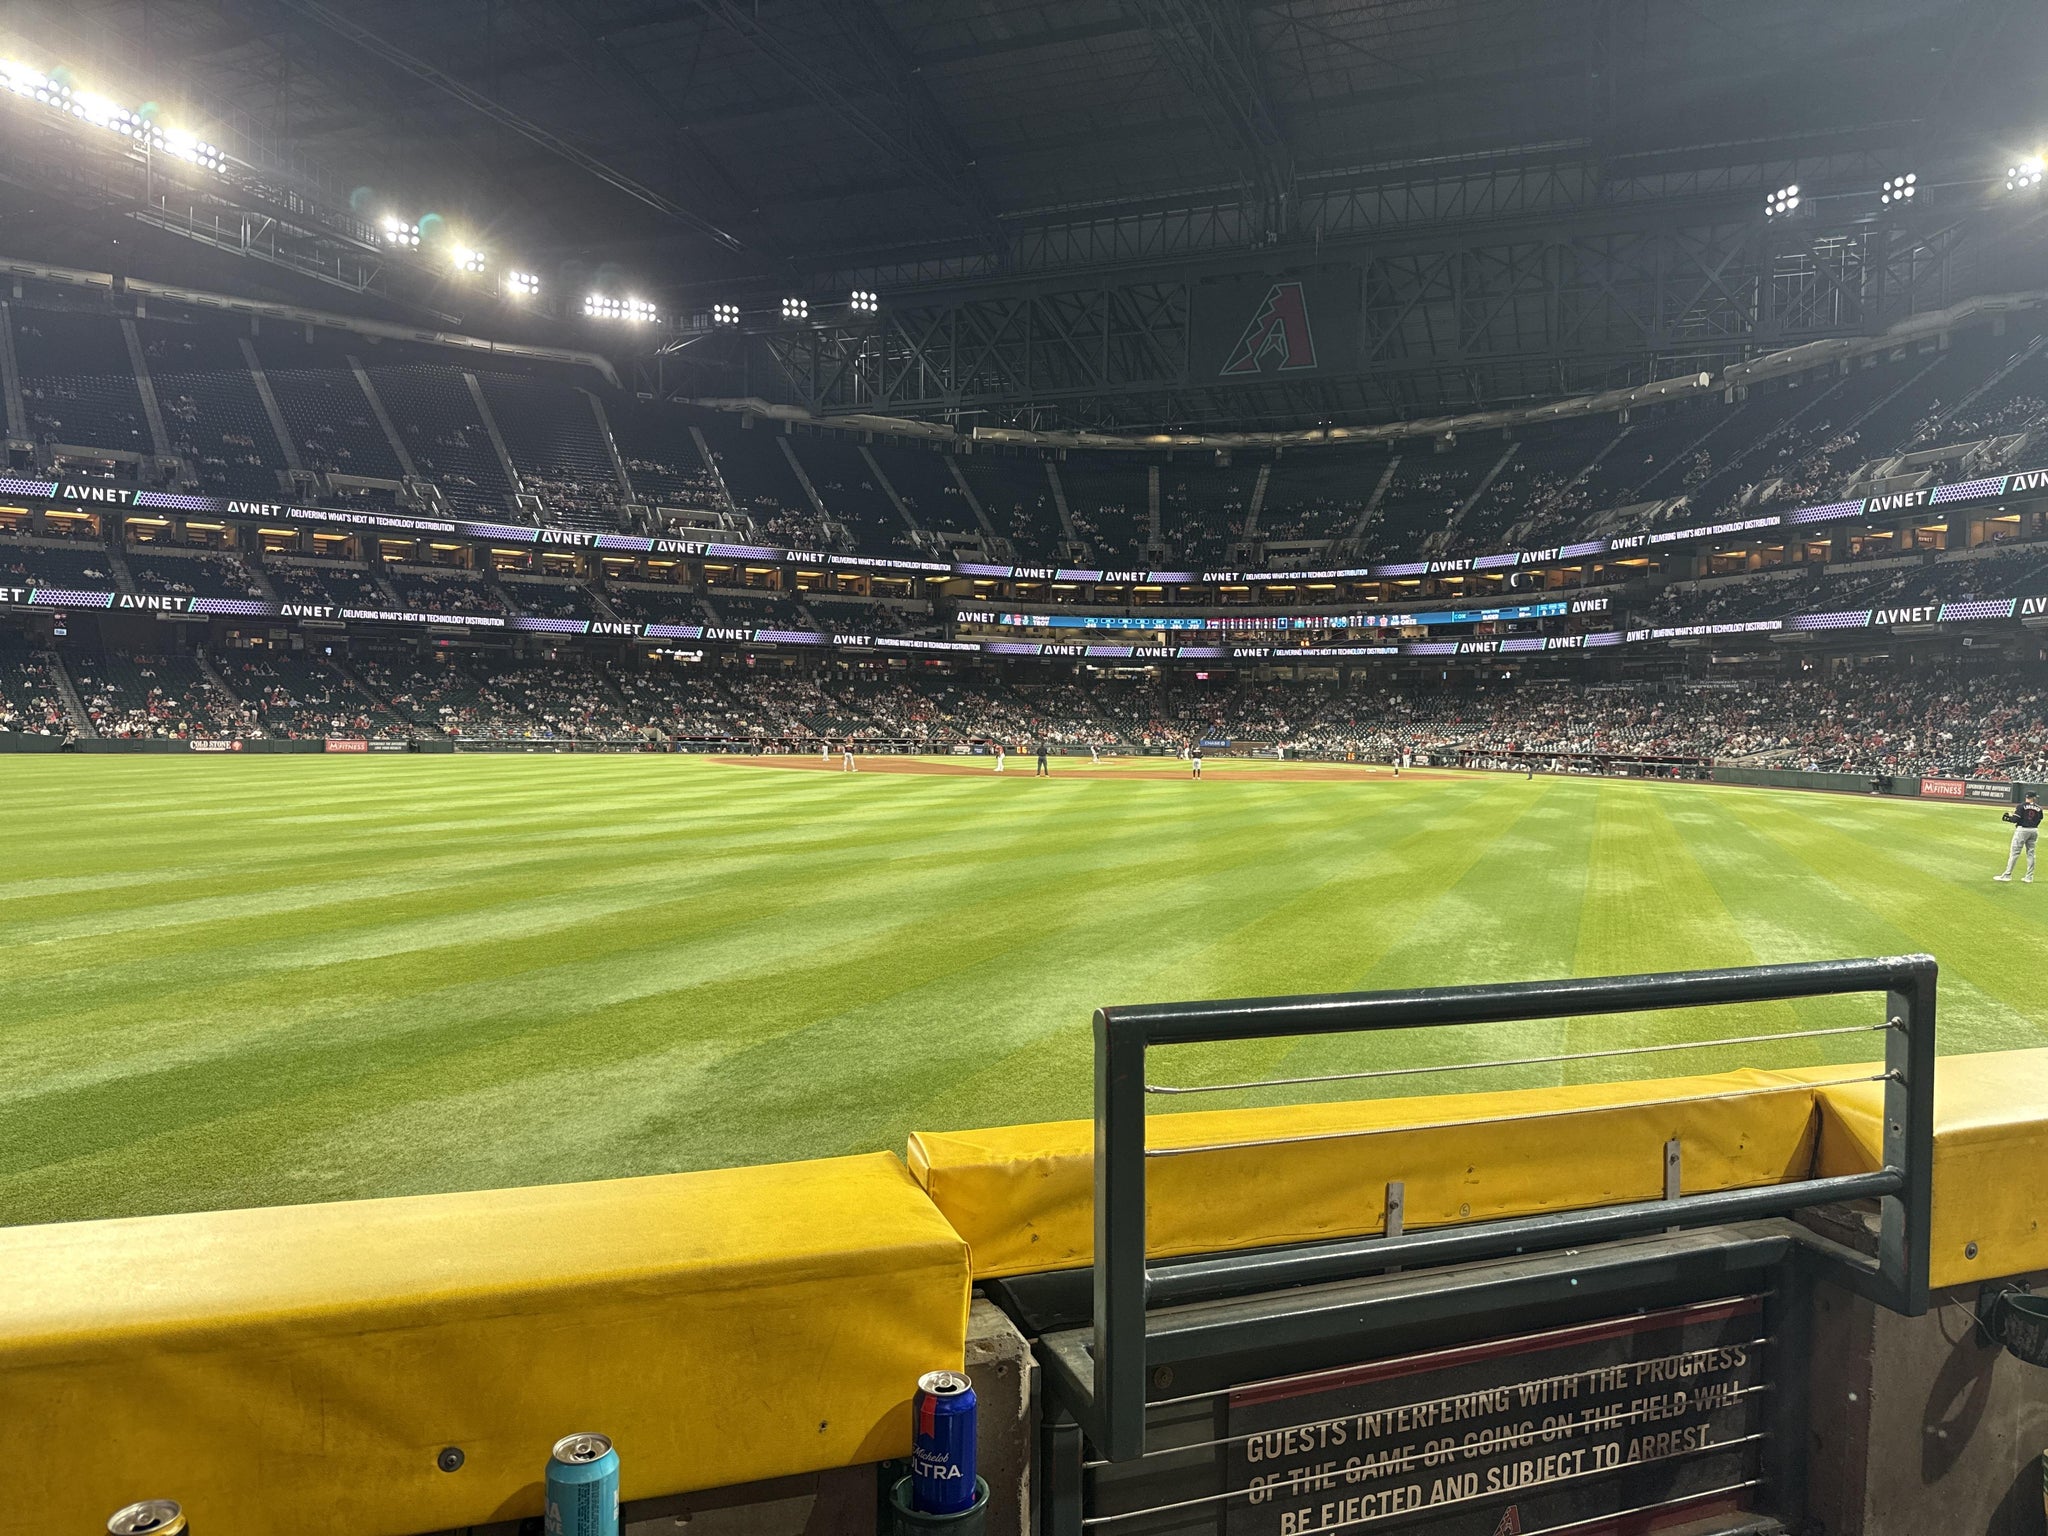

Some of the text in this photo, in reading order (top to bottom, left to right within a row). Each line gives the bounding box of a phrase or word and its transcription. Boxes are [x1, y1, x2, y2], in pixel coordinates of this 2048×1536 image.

[64, 485, 131, 503] AVNET
[1869, 490, 1927, 513] AVNET
[227, 501, 455, 532] AVNET DELIVERING WHAT'S NEXT IN TECHNOLOGY DISTRIBUTION
[541, 531, 592, 546] AVNET
[1611, 535, 1645, 550] AVNET
[657, 541, 704, 555] AVNET
[786, 551, 825, 564] AVNET
[1521, 548, 1559, 564] AVNET
[1430, 559, 1472, 572] AVNET
[1014, 567, 1054, 579] AVNET
[1105, 571, 1146, 582] AVNET
[1202, 572, 1240, 582] AVNET
[119, 594, 187, 611] AVNET
[1572, 598, 1609, 613] AVNET
[281, 604, 505, 627] AVNET DELIVERING WHAT'S NEXT IN TECHNOLOGY DISTRIBUTION
[957, 611, 995, 623] AVNET
[1875, 606, 1936, 625] AVNET
[592, 622, 643, 635] AVNET
[706, 628, 753, 641] AVNET
[833, 634, 872, 646] AVNET
[1626, 629, 1650, 642] AVNET
[1460, 641, 1499, 654] AVNET
[1548, 636, 1584, 649] AVNET
[1044, 645, 1084, 656] AVNET
[1136, 647, 1177, 658] AVNET
[1233, 648, 1270, 658] AVNET
[190, 740, 232, 749] COLD STONE
[1934, 785, 1962, 795] FITNESS
[1247, 1345, 1747, 1463] GUESTS INTERFERING WITH THE PROGRESS
[1249, 1381, 1744, 1505] OF THE GAME OR GOING ON THE FIELD WILL
[913, 1443, 950, 1463] Michelob
[1280, 1423, 1715, 1536] BE EJECTED AND SUBJECT TO ARREST.
